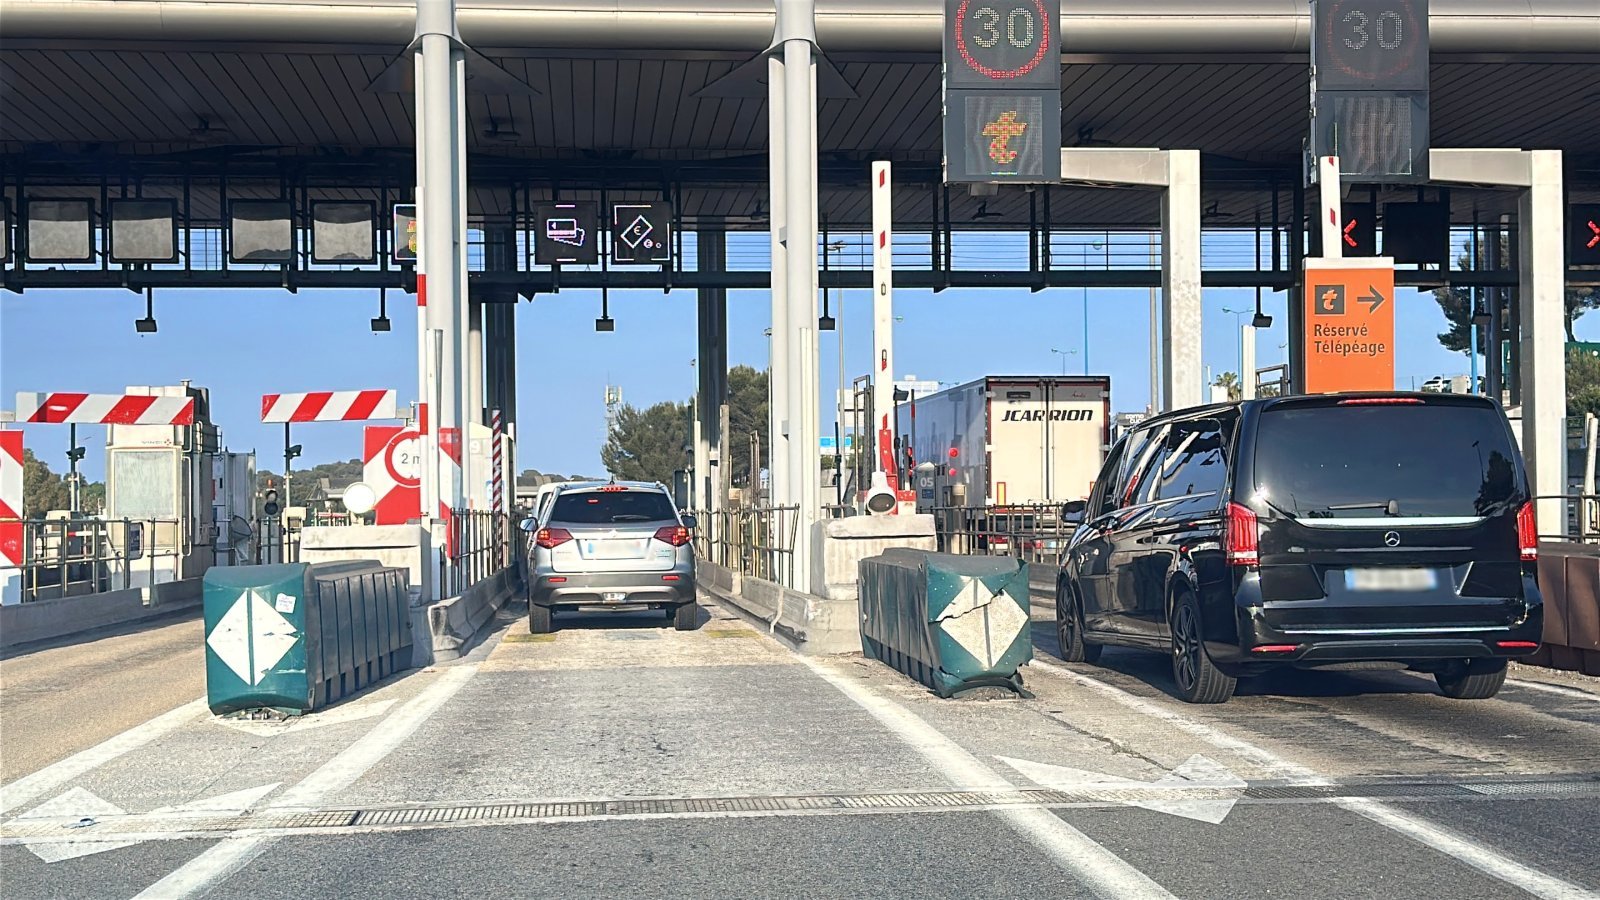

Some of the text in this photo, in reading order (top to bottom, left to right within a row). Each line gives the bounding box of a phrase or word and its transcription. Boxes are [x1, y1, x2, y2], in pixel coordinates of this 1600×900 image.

[973, 7, 1034, 48] 30
[1343, 10, 1402, 50] 30
[1314, 323, 1368, 337] Réservé
[1314, 340, 1385, 357] Télépéage
[401, 453, 408, 464] 2
[920, 477, 934, 488] 05
